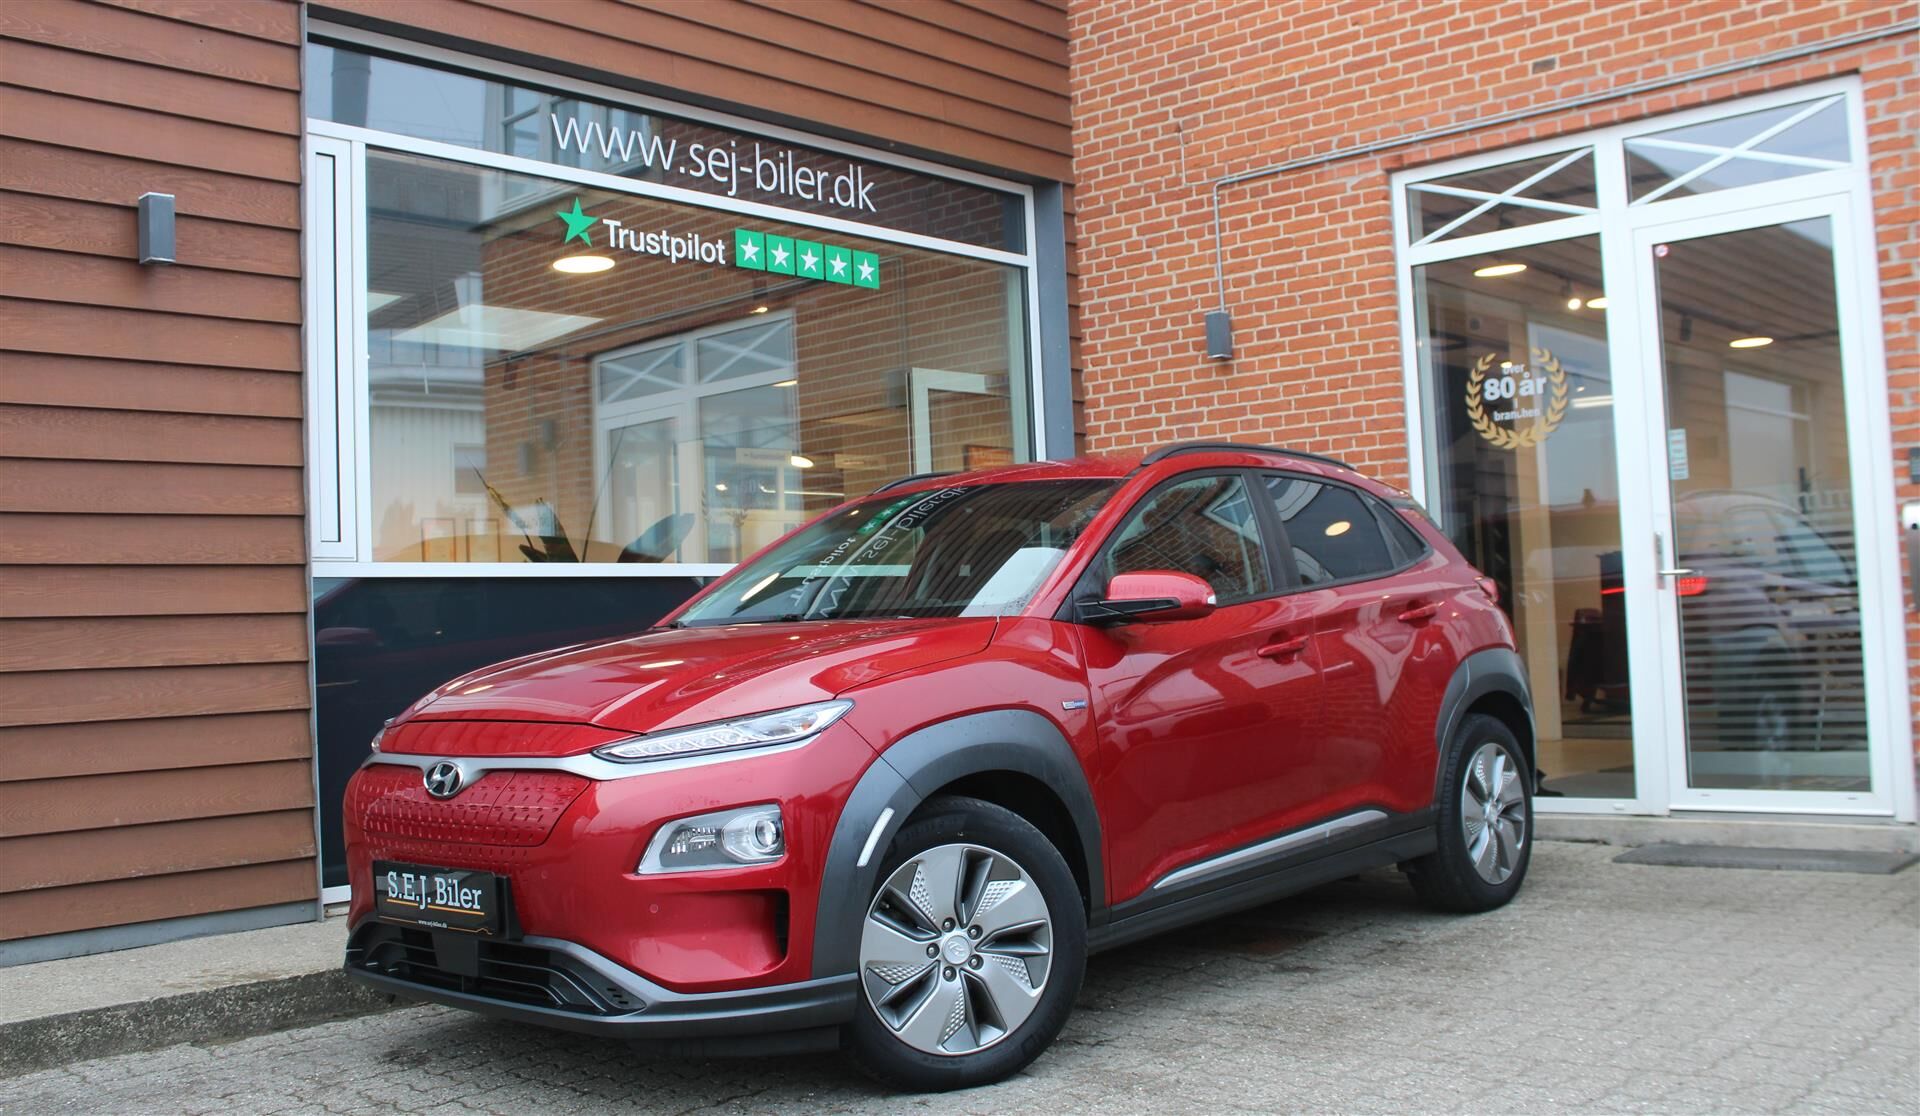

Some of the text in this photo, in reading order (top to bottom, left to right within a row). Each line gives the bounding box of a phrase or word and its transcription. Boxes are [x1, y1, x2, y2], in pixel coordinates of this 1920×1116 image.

[551, 113, 877, 213] www.sej-biler.dk
[602, 218, 726, 265] Trustpilot
[1483, 371, 1547, 401] 80 år
[387, 870, 482, 910] S.E.J. Biler
